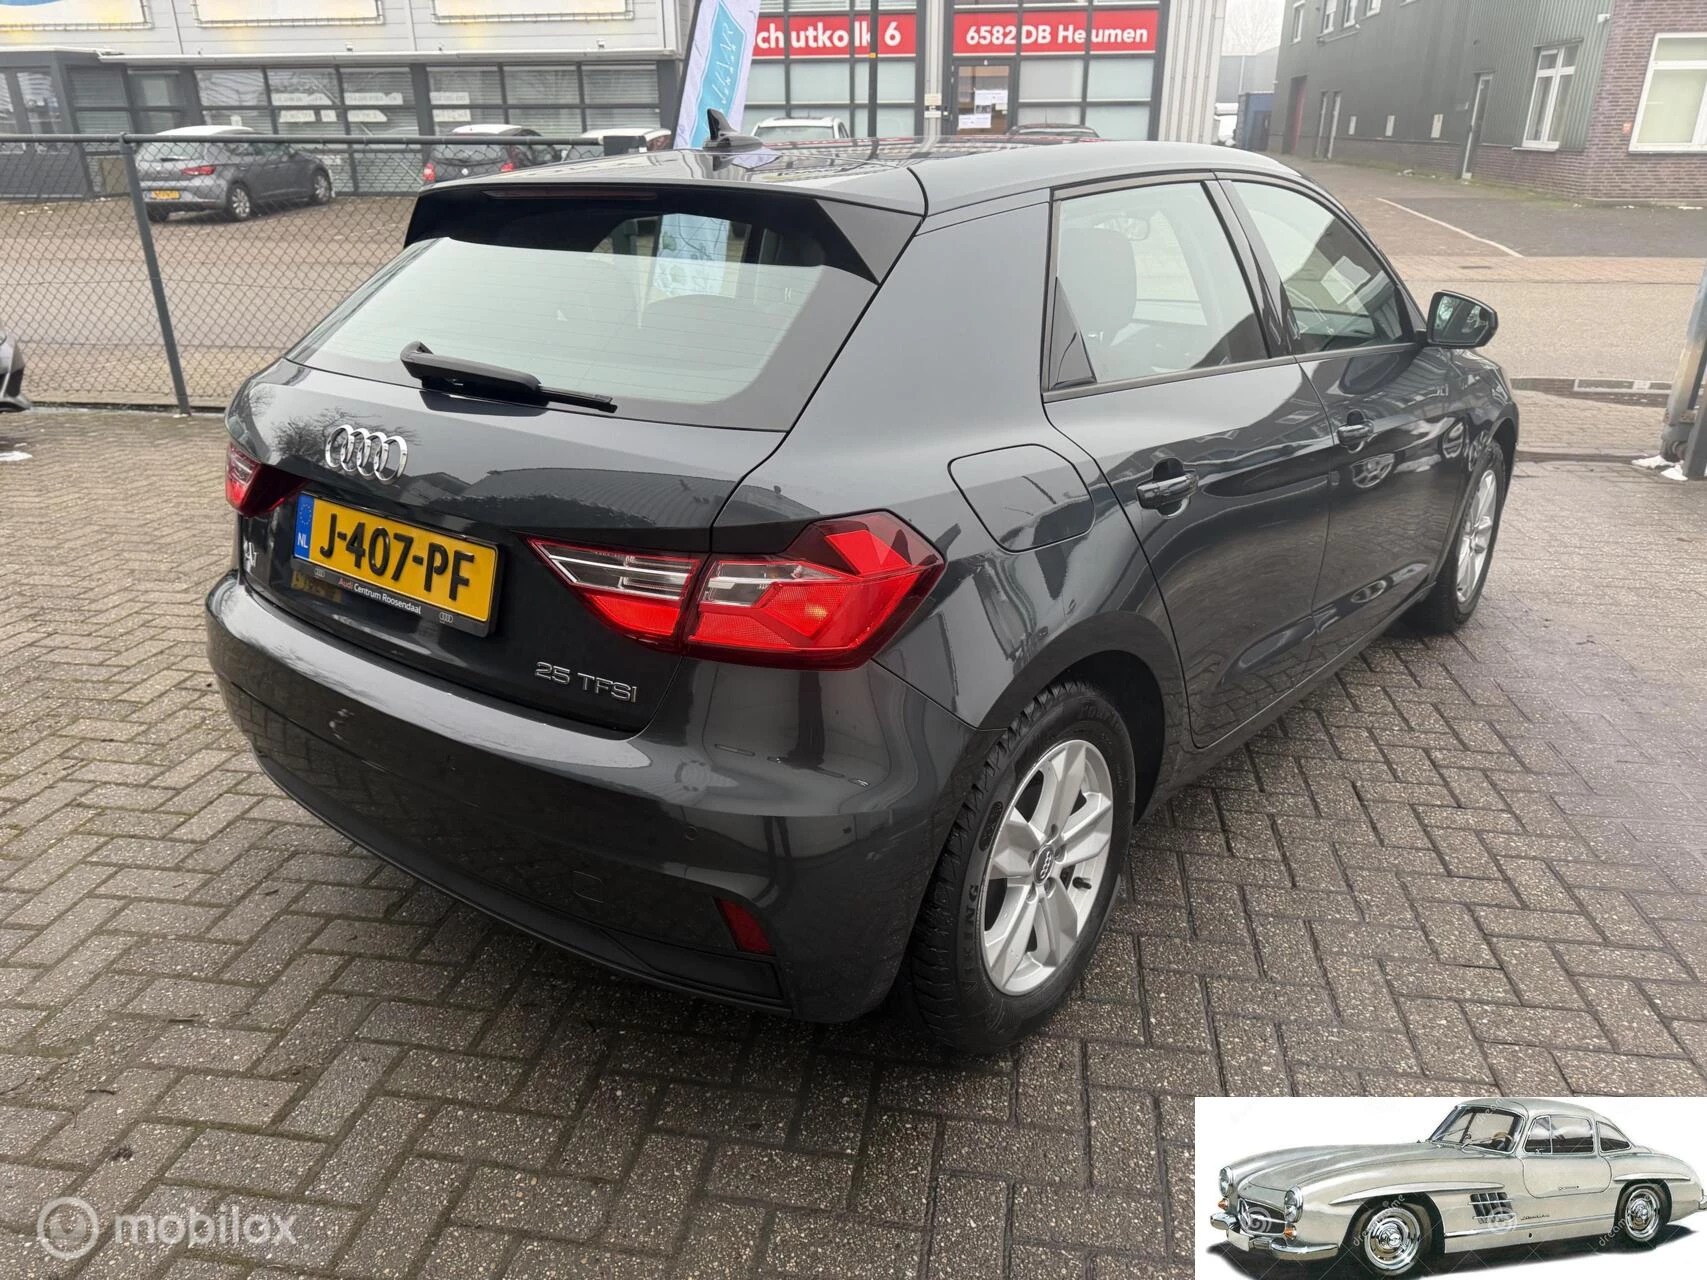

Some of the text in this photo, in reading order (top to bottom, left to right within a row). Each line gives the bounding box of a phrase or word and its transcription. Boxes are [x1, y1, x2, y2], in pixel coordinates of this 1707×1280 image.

[754, 20, 902, 49] chutkolk 6
[966, 23, 1148, 45] 6582 DB Heumen
[297, 532, 309, 549] NL
[319, 513, 475, 601] J-407-PF
[338, 578, 422, 615] Audi Centrum Roosendaal
[535, 661, 638, 703] 25 TFSI
